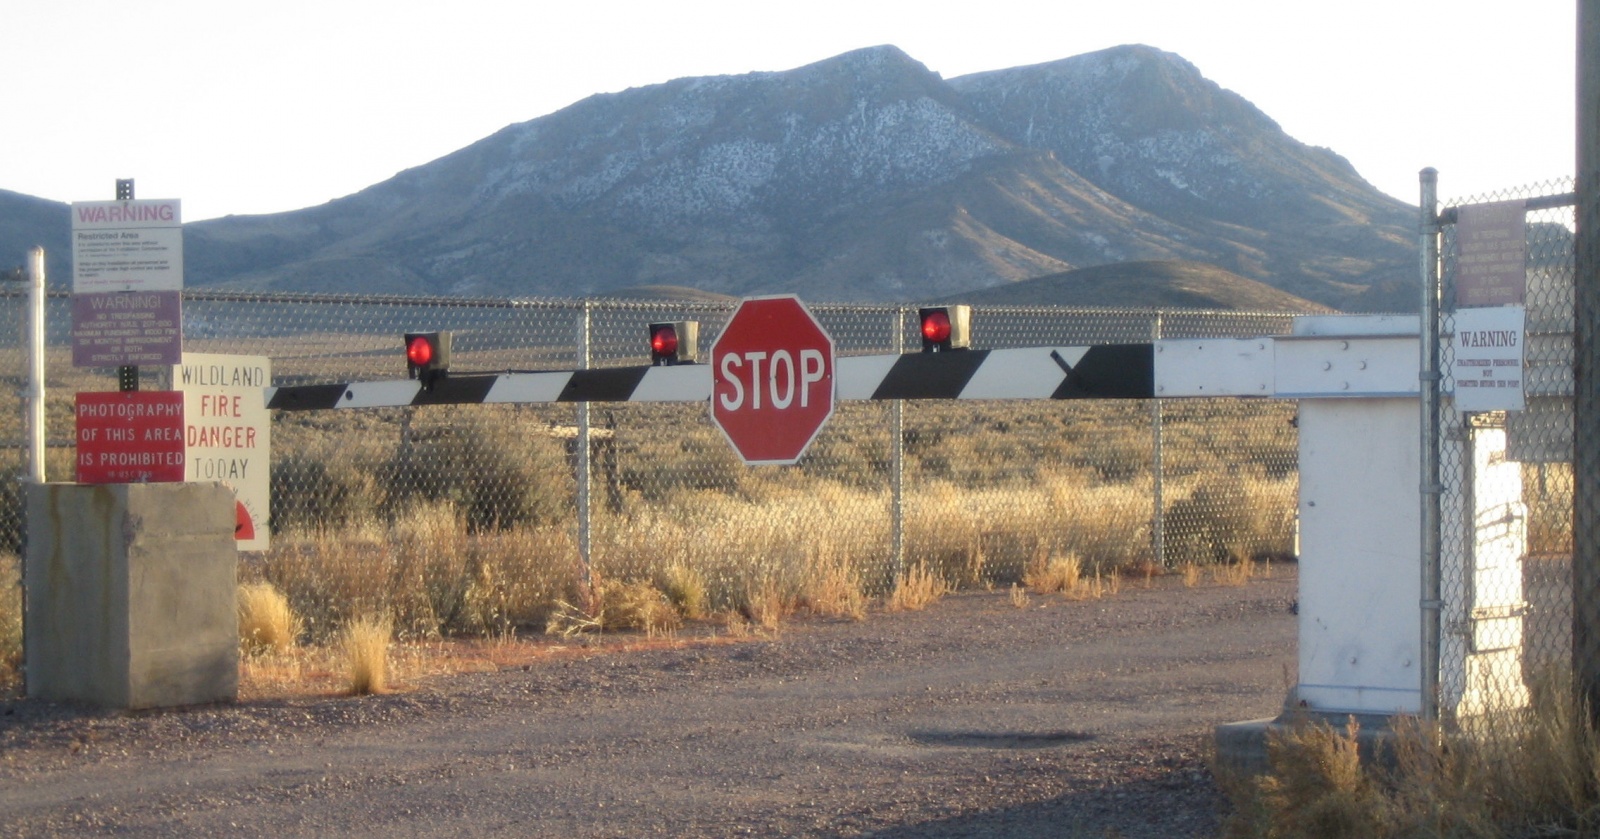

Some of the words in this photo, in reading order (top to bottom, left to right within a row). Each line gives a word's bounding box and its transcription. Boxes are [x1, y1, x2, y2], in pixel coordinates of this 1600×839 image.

[78, 204, 174, 222] WARNING
[78, 232, 118, 240] Restricted
[90, 295, 161, 309] WARNING!
[1460, 331, 1517, 347] WARNING
[182, 365, 264, 387] WILDLAND
[720, 349, 825, 411] STOP
[80, 403, 182, 417] PHOTOGRAPHY
[201, 395, 242, 417] FIRE
[82, 428, 98, 441] OF
[105, 428, 135, 441] THIS
[144, 428, 182, 440] AREA
[187, 425, 256, 448] DANGER
[80, 453, 93, 466] IS
[100, 452, 183, 466] PROHIBITED
[195, 457, 249, 479] TODAY
